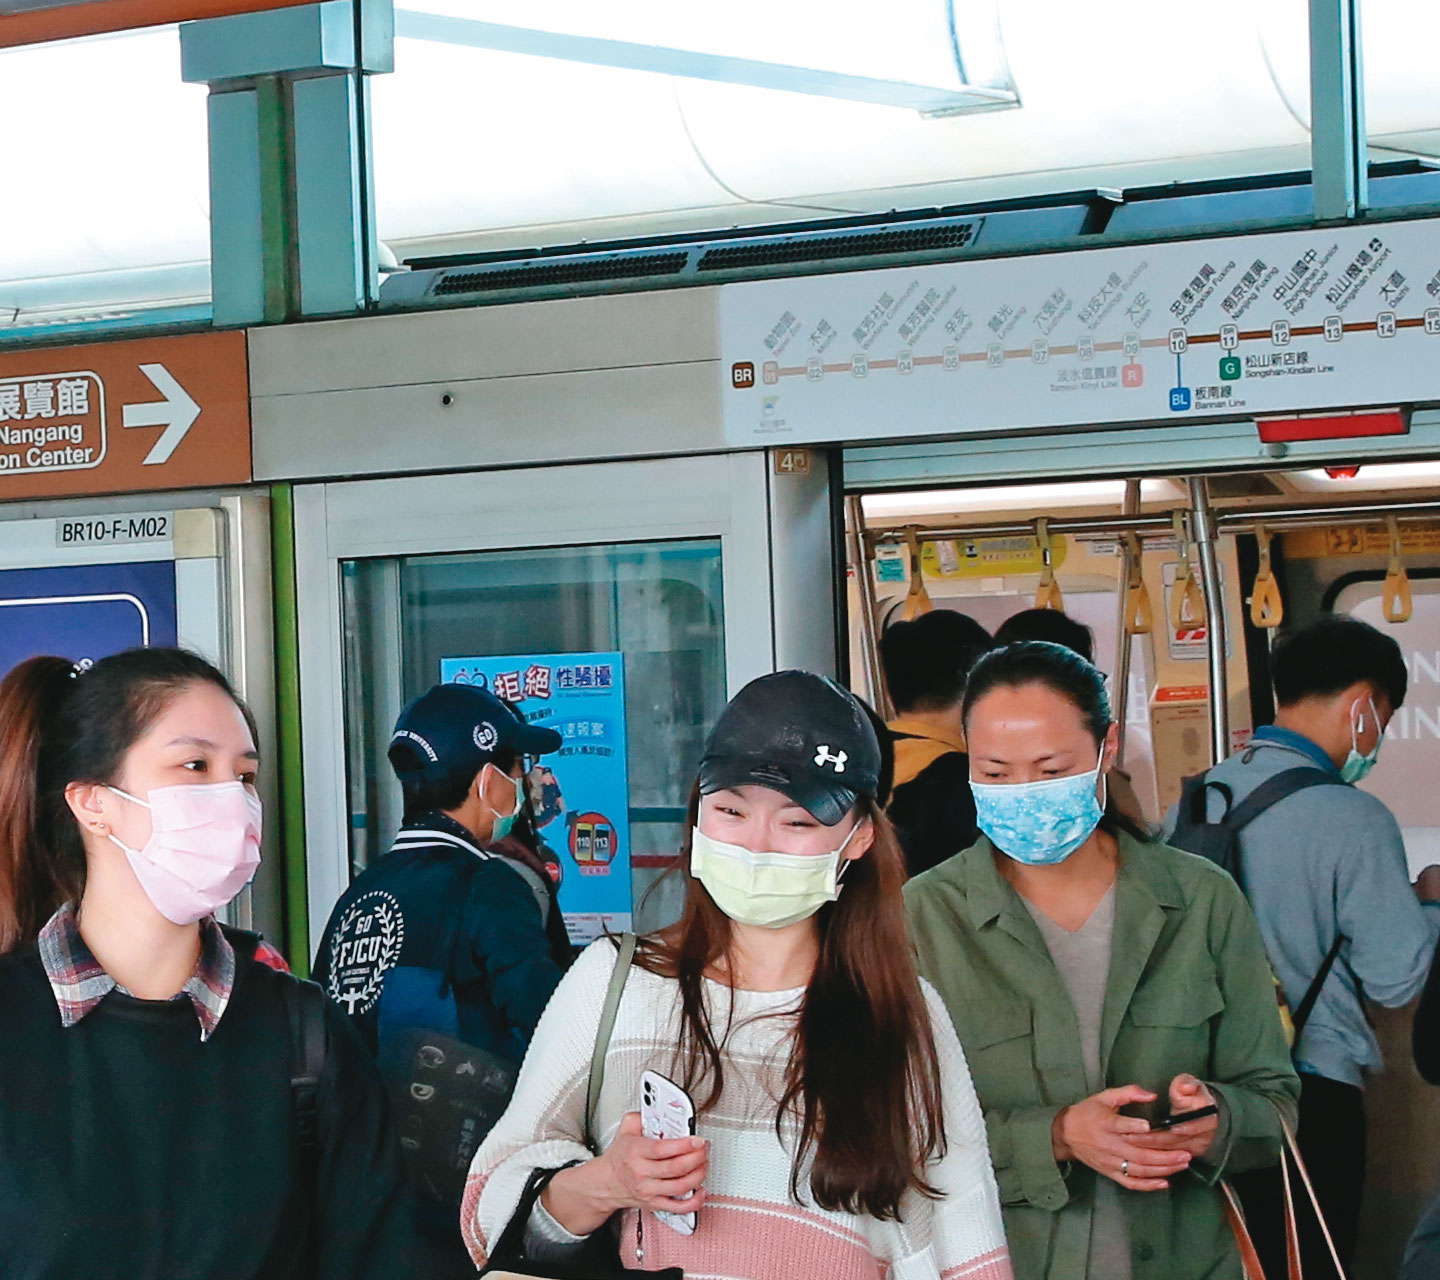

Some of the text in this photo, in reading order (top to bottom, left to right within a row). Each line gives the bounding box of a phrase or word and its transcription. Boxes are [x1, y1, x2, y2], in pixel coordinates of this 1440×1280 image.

[1272, 248, 1318, 301] 中山國中
[1169, 263, 1217, 318] 忠孝復興
[1379, 323, 1394, 335] 14
[1427, 321, 1440, 332] 15
[1274, 332, 1288, 344] 12
[1326, 327, 1340, 339] 13
[1171, 339, 1185, 351] 10
[1222, 336, 1236, 347] 11
[1225, 362, 1235, 373] G
[733, 368, 753, 383] BR
[1172, 393, 1188, 406] BL
[25, 445, 95, 468] Center
[61, 517, 168, 543] BR10-F-M02
[337, 935, 383, 969] FJCU
